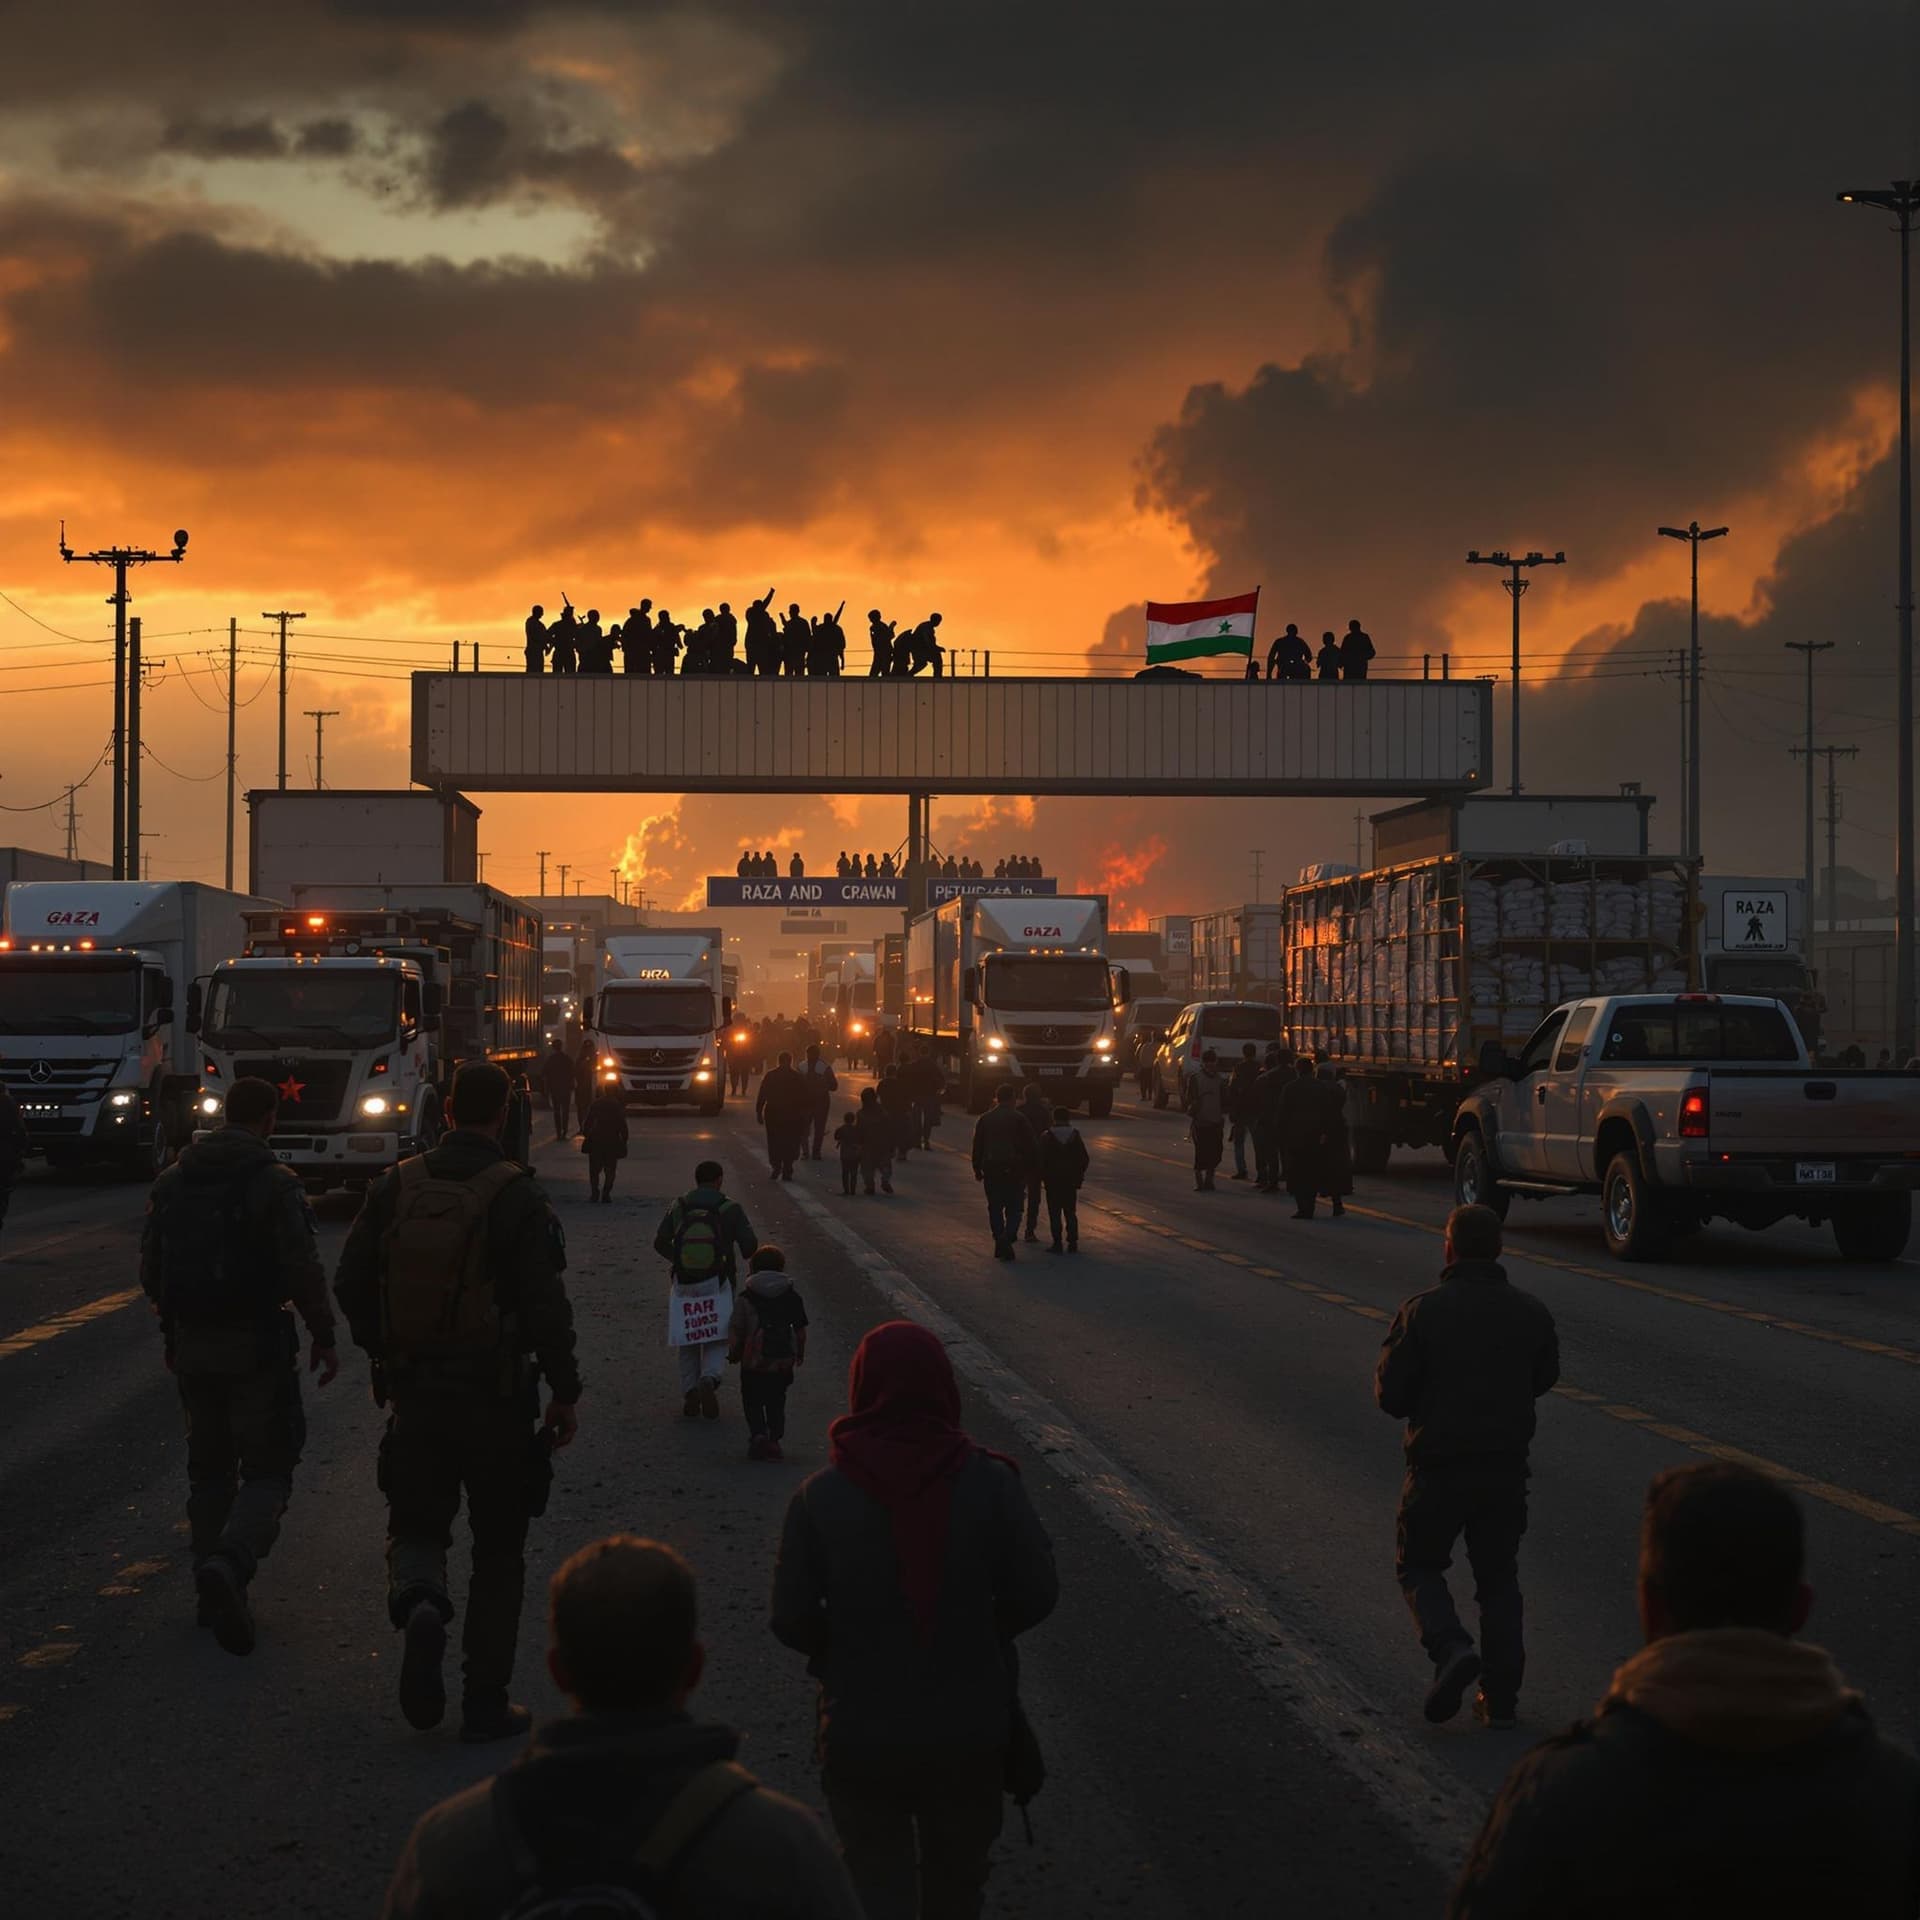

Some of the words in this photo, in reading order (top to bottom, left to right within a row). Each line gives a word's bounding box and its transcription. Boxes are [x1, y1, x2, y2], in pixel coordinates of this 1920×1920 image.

[741, 884, 782, 900] RAZA
[789, 884, 823, 900] AND
[1736, 900, 1775, 914] RAZA
[47, 911, 100, 926] GAZA
[1023, 926, 1061, 937] GAZA
